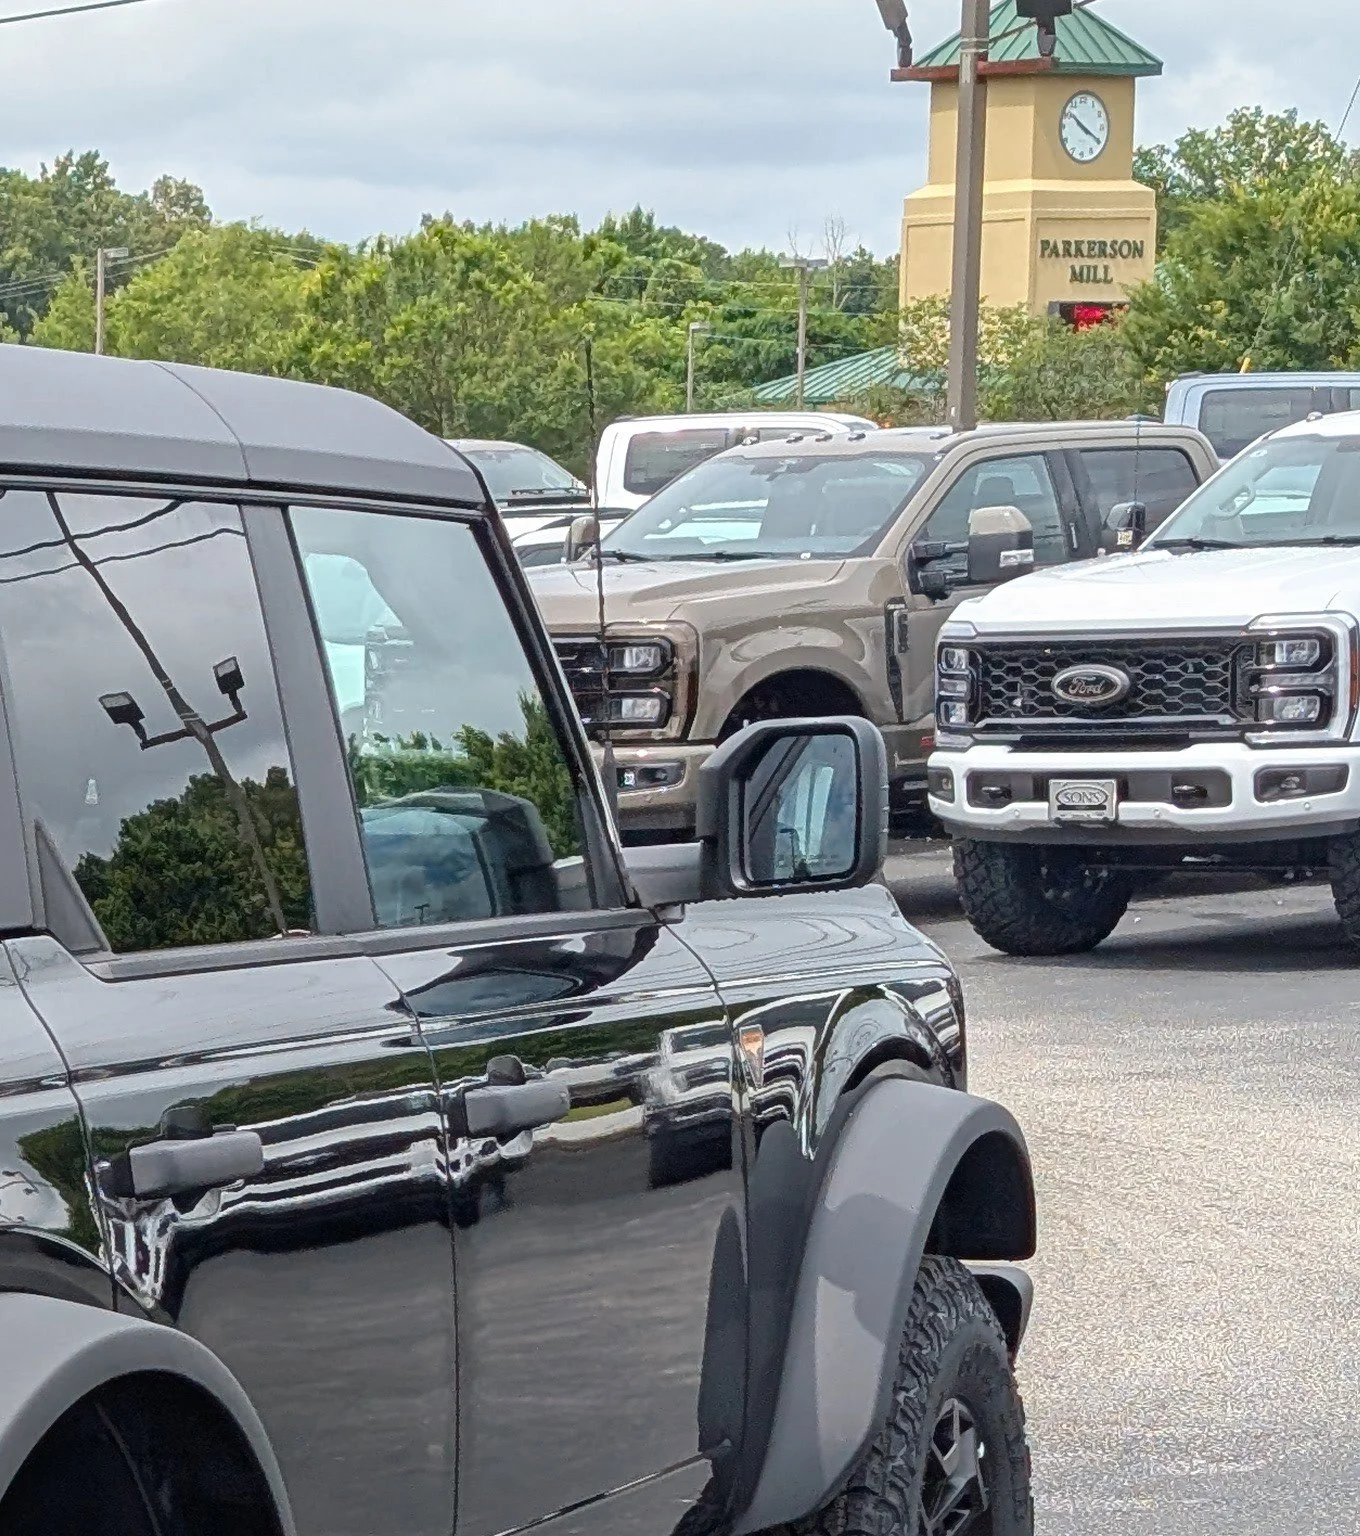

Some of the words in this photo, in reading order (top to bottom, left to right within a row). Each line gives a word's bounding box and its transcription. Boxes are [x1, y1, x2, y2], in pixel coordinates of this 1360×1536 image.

[1040, 239, 1145, 259] PARKERSON
[1069, 264, 1113, 283] MILL
[1067, 675, 1106, 695] Ford
[1063, 790, 1103, 804] SONS
